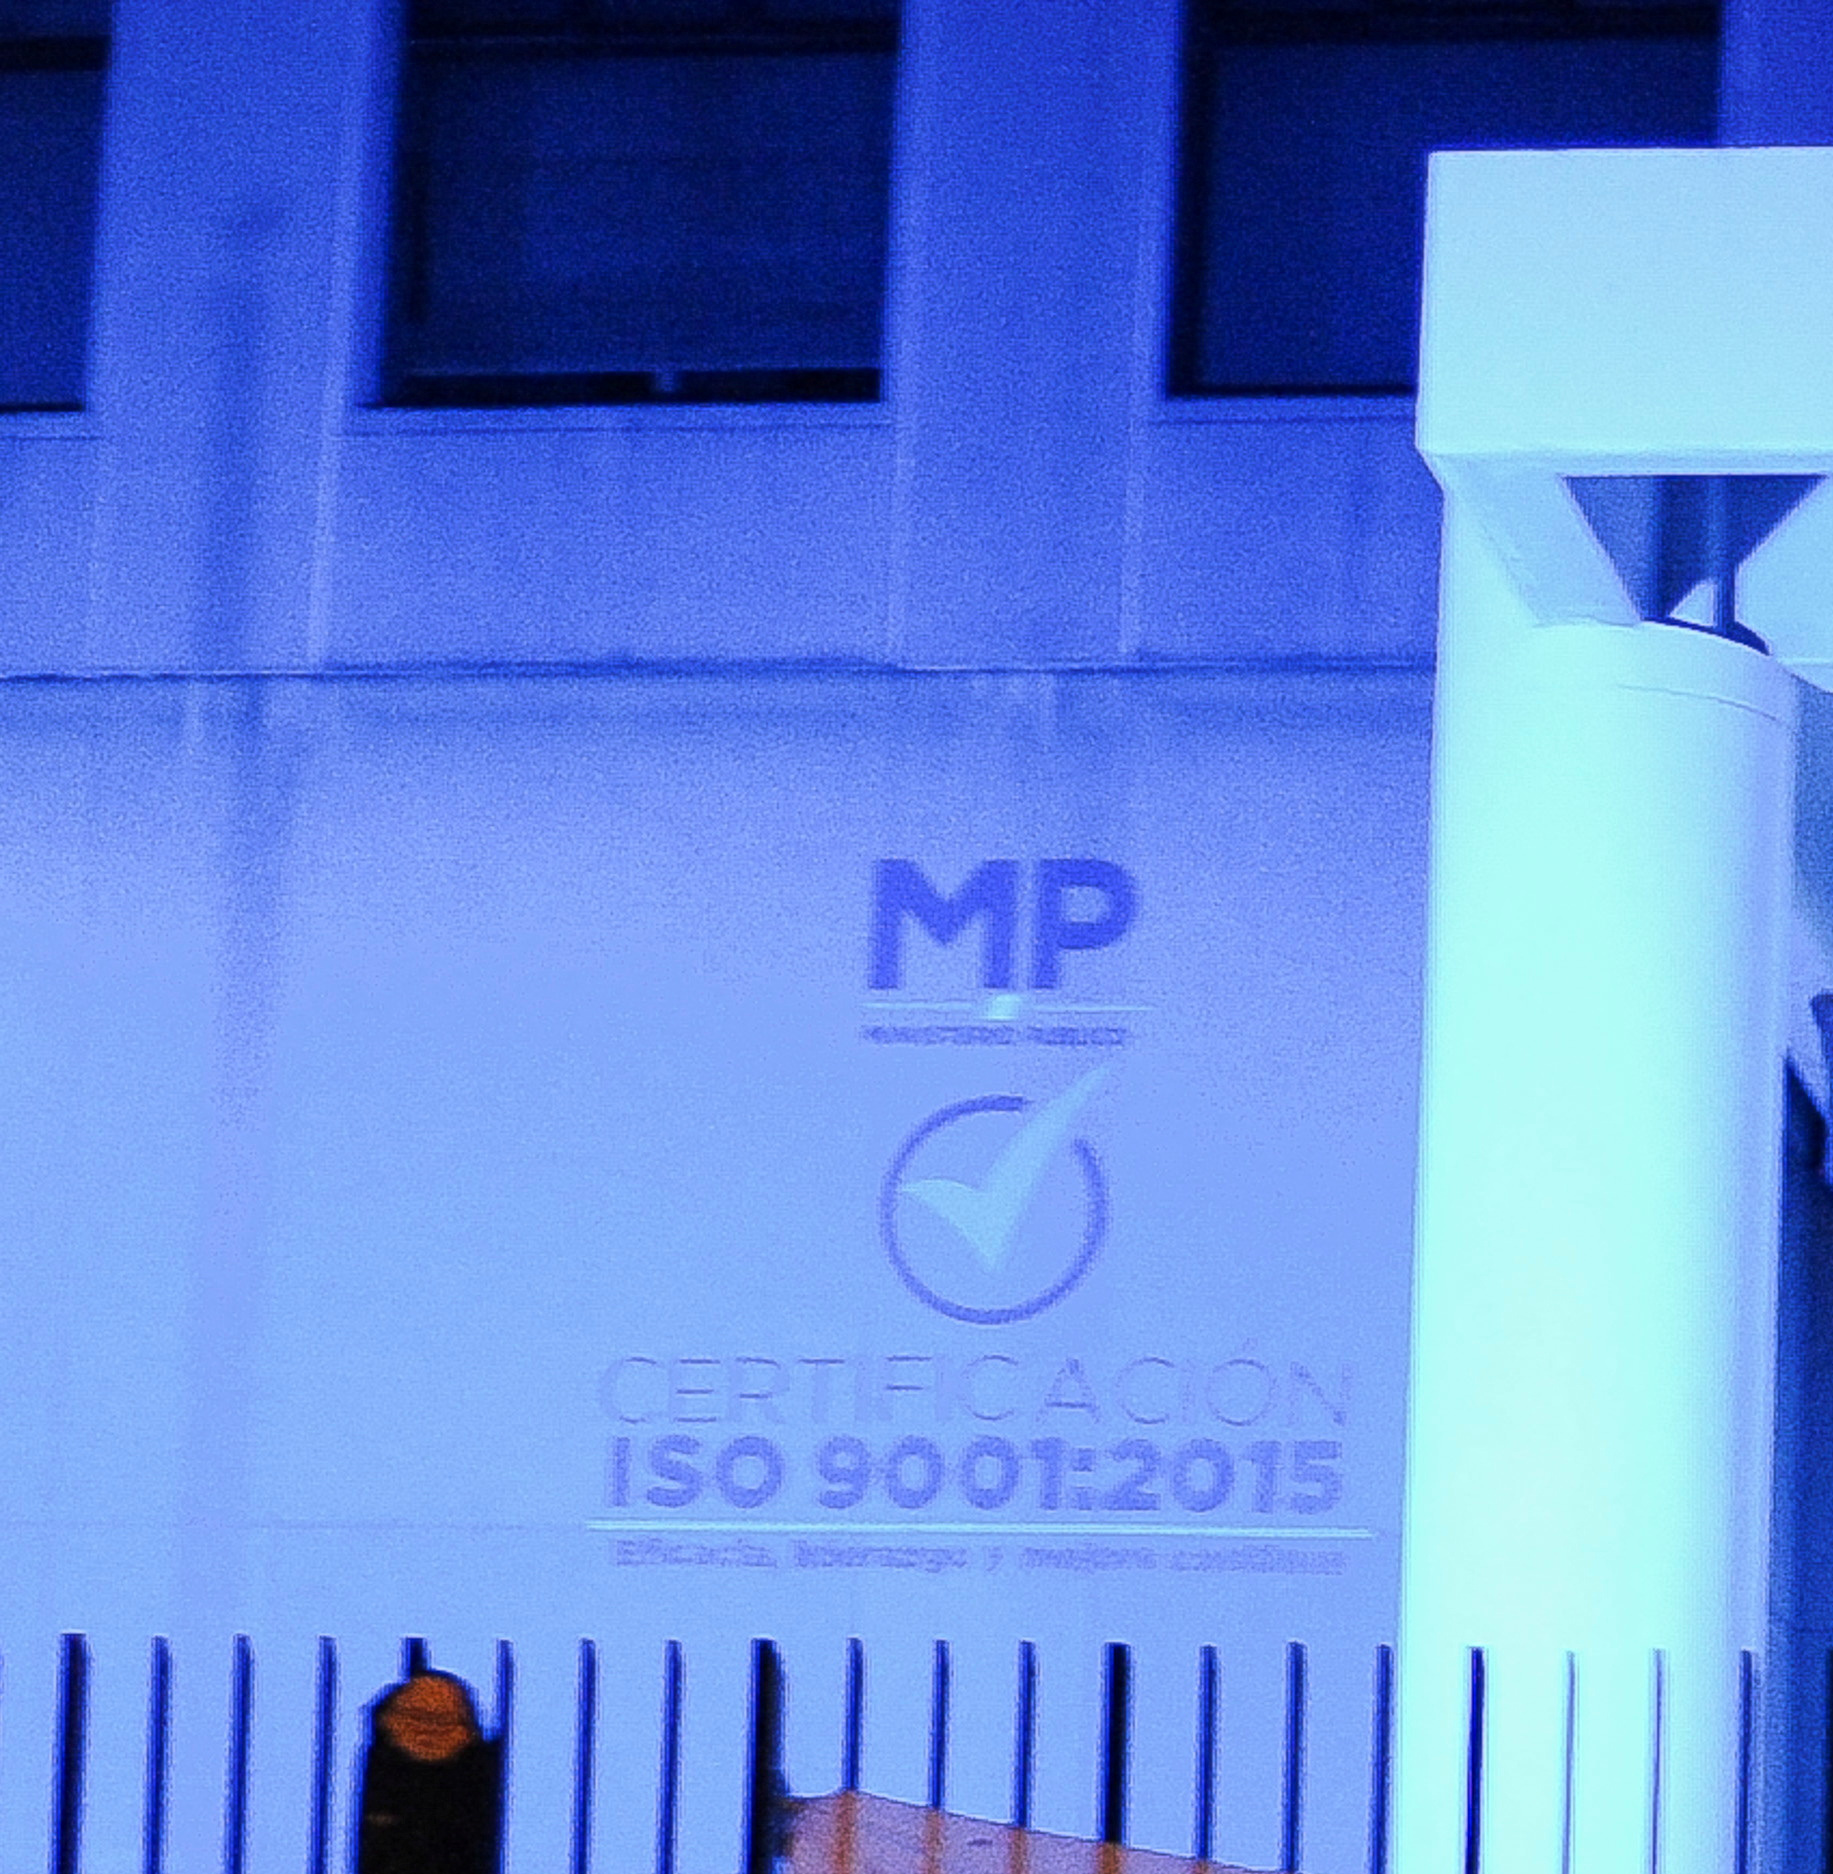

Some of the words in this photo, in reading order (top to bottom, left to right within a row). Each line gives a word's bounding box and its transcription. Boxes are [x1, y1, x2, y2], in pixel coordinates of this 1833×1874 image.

[868, 857, 1140, 990] MP
[602, 1340, 1354, 1428] CERTIFICACIÓN
[609, 1434, 784, 1509] ISO
[817, 1434, 1346, 1514] 9001:2015
